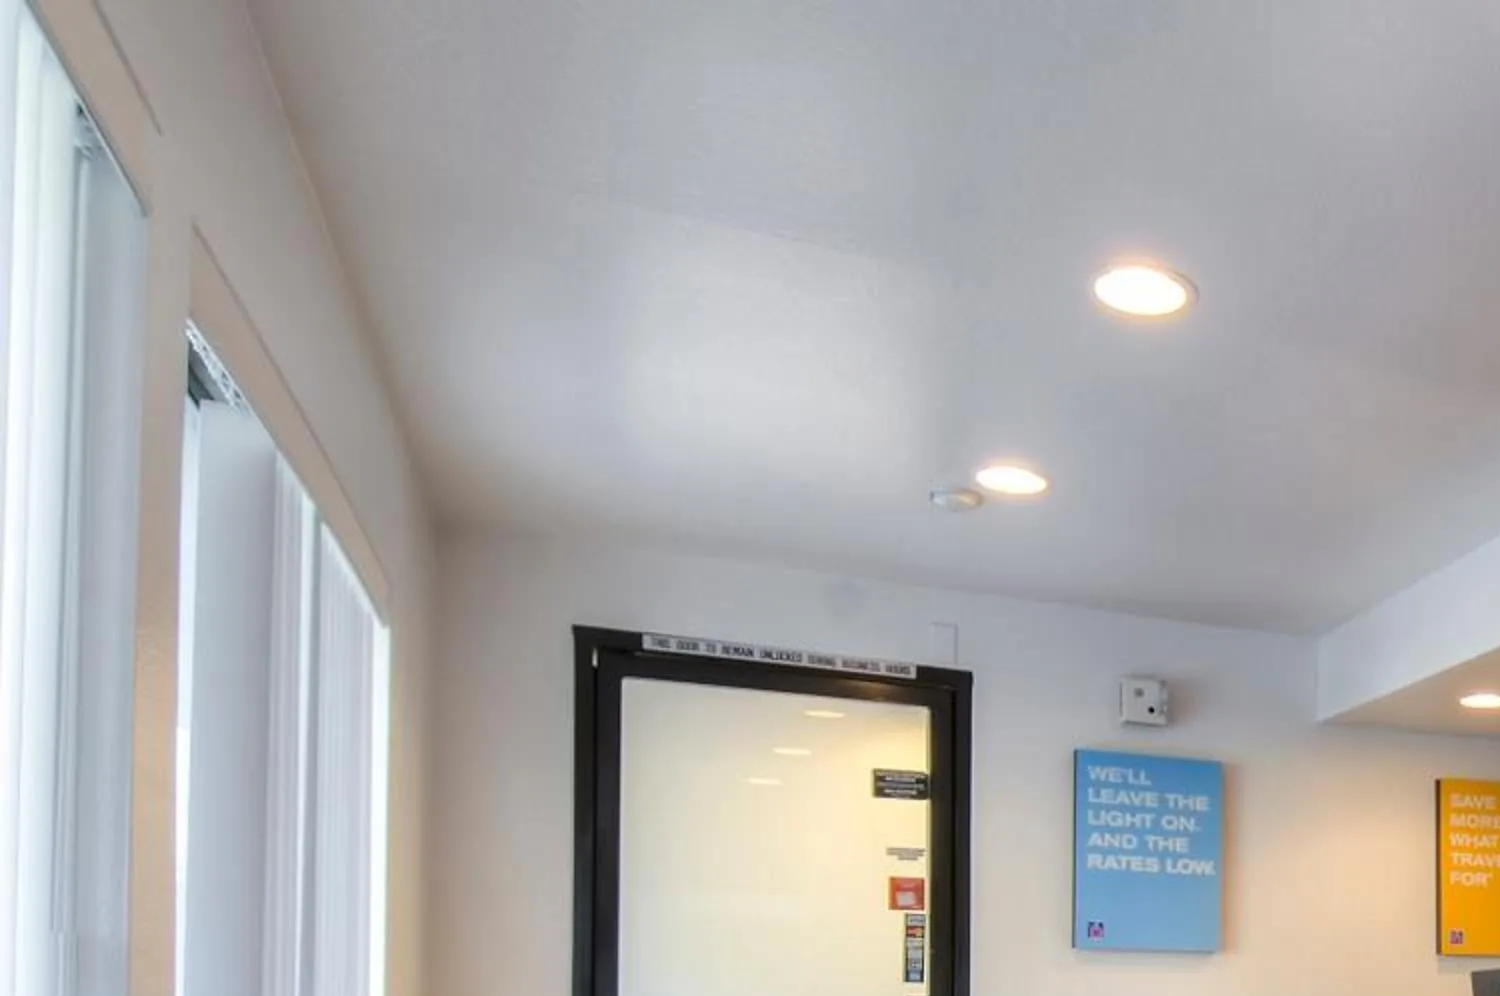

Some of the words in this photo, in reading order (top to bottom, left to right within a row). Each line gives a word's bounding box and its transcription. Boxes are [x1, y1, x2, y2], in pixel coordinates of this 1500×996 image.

[1087, 765, 1151, 785] WE'LL
[1088, 787, 1159, 808] LEAVE
[1164, 793, 1210, 812] THE
[1450, 793, 1497, 810] SAVE
[1088, 810, 1155, 829] LIGHT
[1087, 833, 1137, 850] AND
[1146, 836, 1190, 853] THE
[1449, 833, 1499, 849] WHAT
[1087, 854, 1160, 873] RATES
[1166, 858, 1216, 876] LOW.
